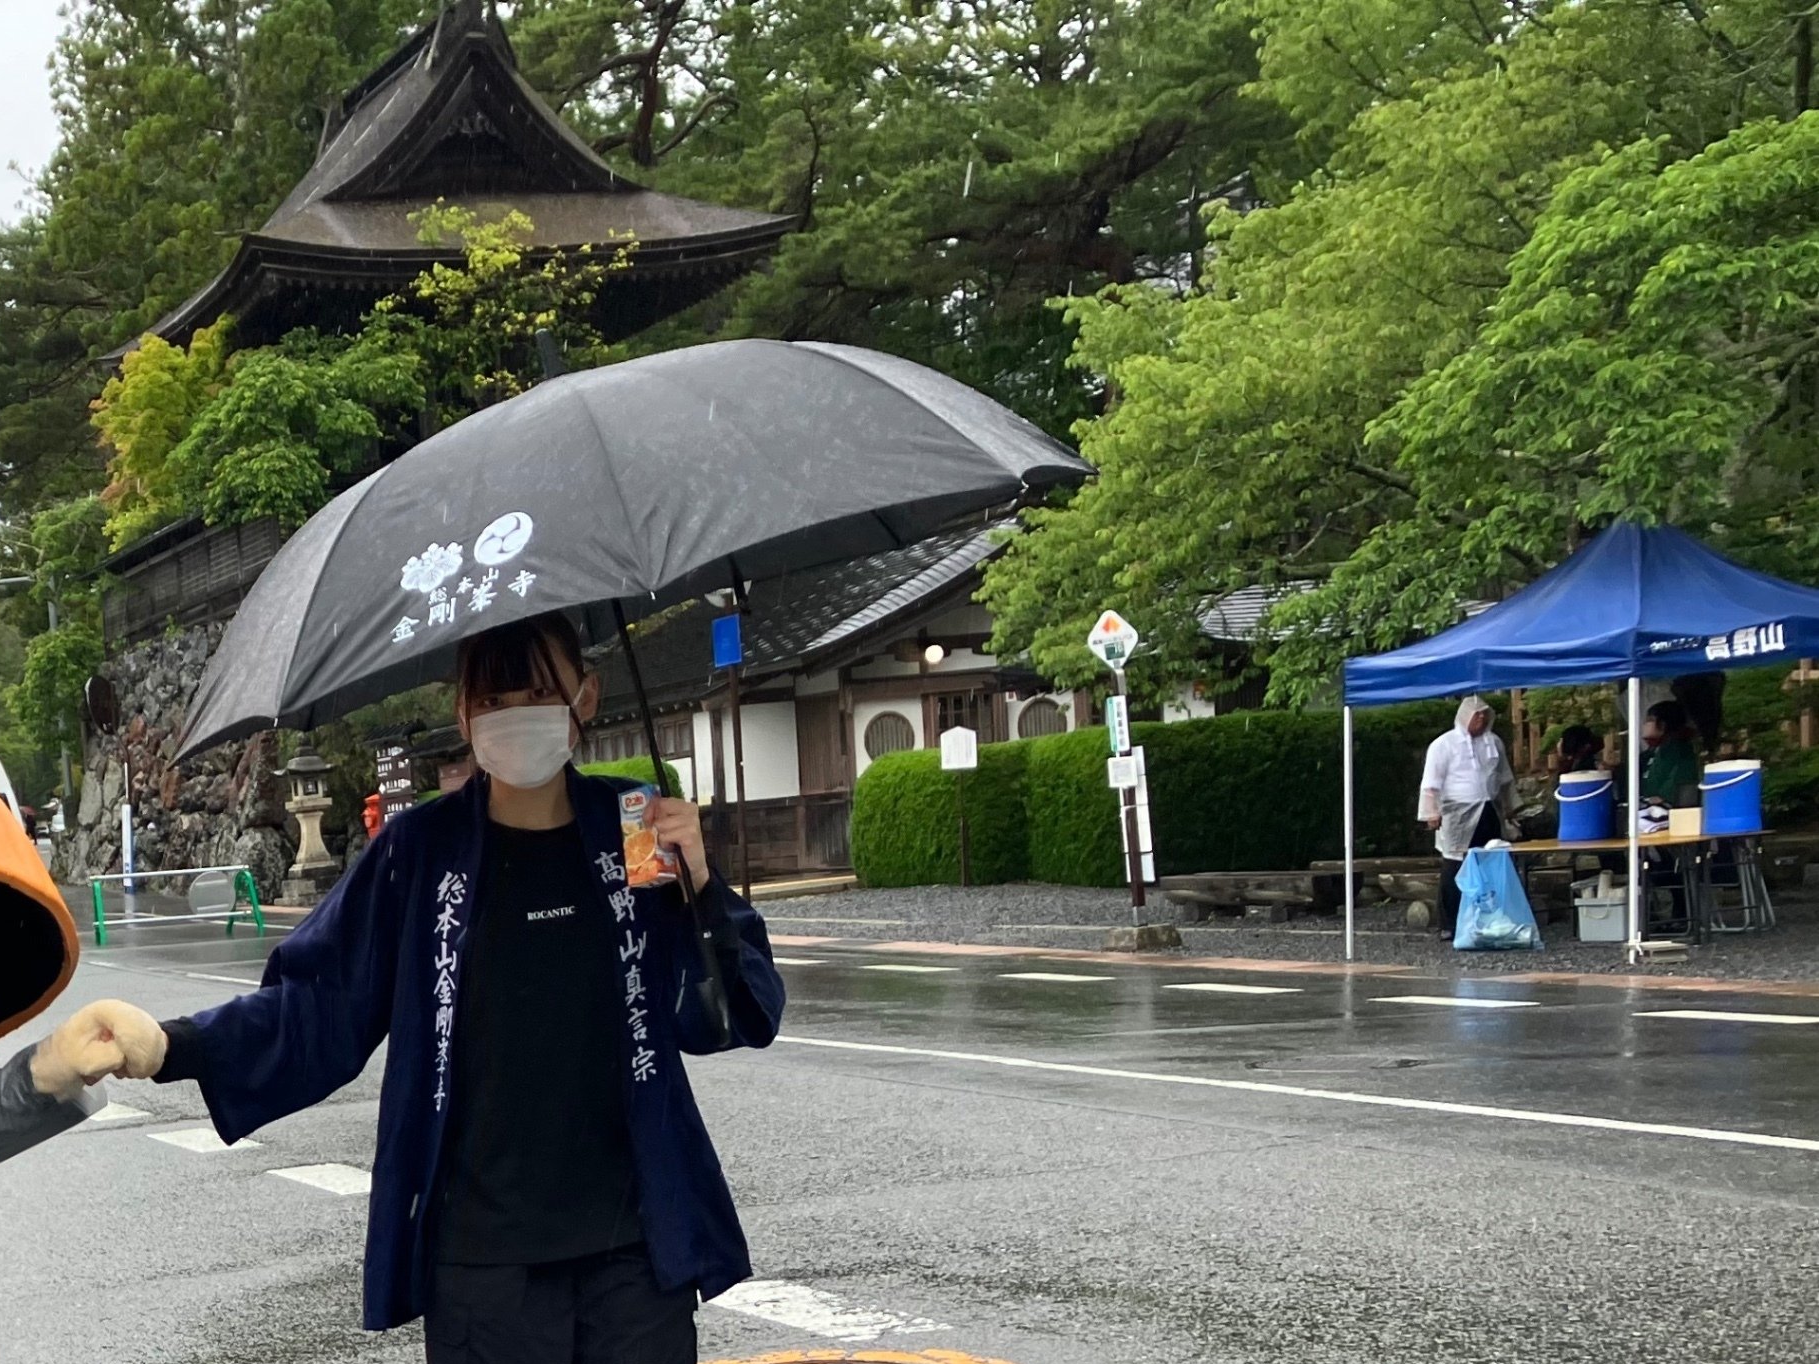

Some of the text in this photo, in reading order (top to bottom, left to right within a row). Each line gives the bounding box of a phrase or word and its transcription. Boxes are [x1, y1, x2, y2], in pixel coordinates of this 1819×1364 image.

[390, 569, 537, 643] 金剛峯寺
[427, 568, 500, 605] 総本山
[527, 905, 576, 921] ROCANTIC
[594, 851, 657, 1082] 高野山真言宗
